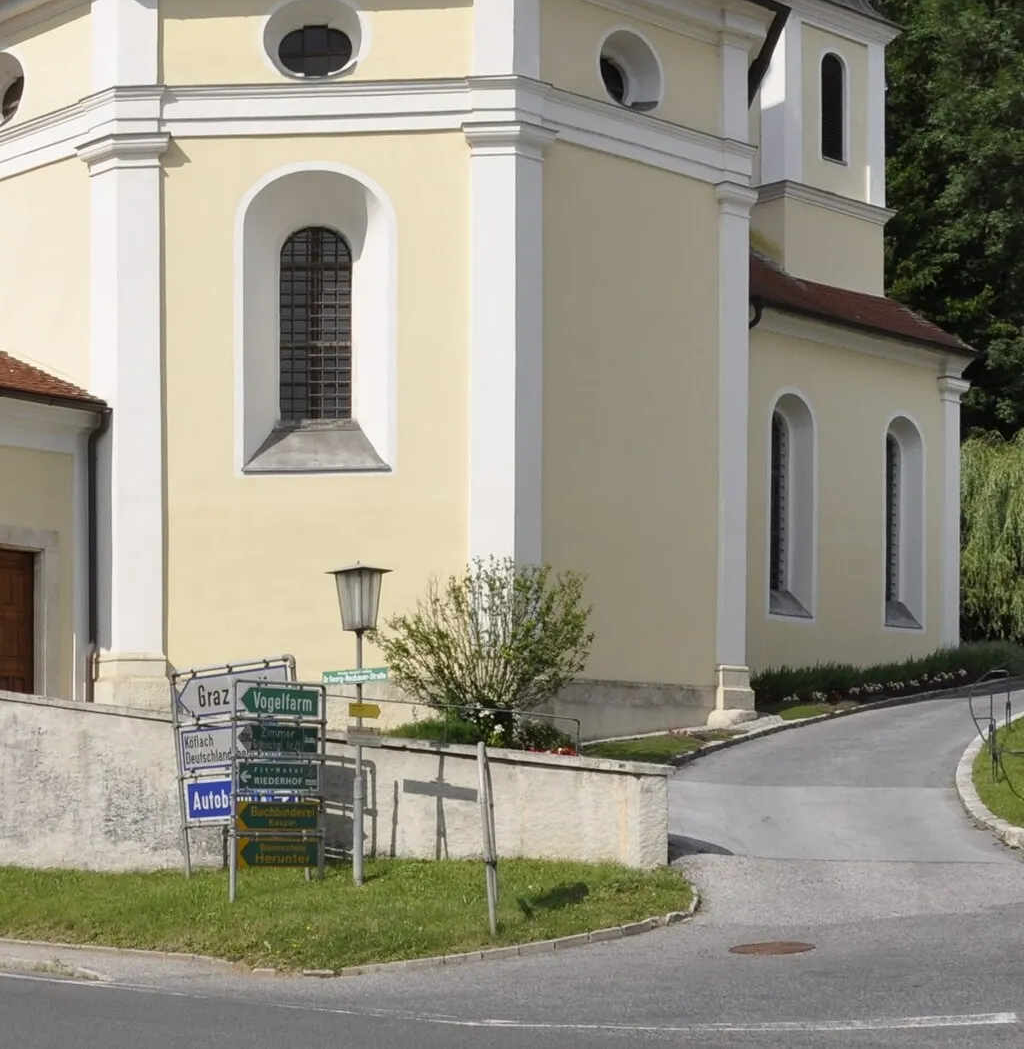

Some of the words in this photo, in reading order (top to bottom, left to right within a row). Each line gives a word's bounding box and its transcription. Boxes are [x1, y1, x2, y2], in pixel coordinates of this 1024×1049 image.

[197, 684, 230, 708] Graz
[253, 691, 313, 713] Vogelfarm
[261, 726, 295, 739] Zimmer
[184, 733, 214, 749] Köflach
[254, 777, 303, 785] RIEDERHOF
[250, 806, 316, 818] Buchbinderei
[255, 853, 310, 864] Herunter
